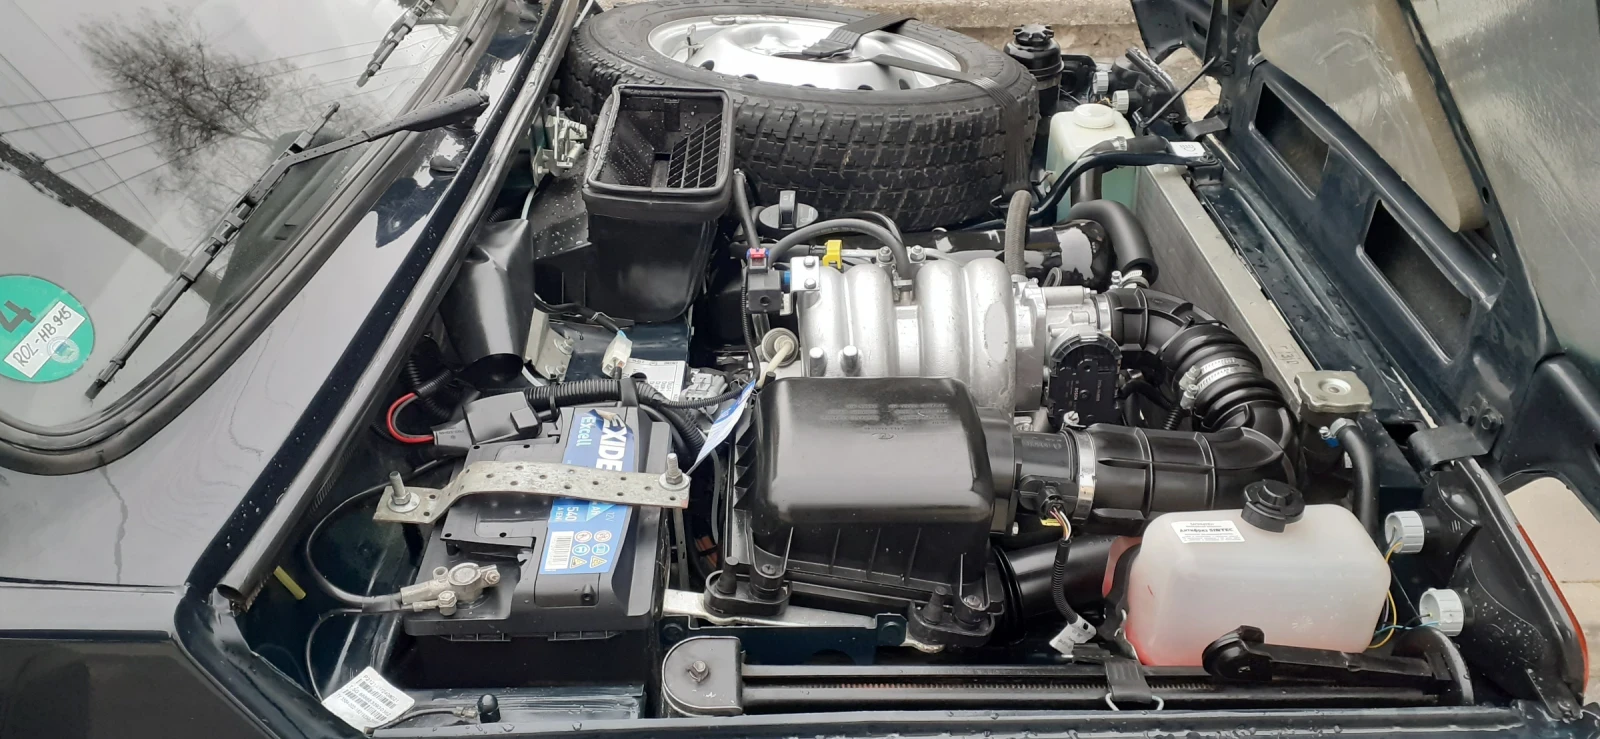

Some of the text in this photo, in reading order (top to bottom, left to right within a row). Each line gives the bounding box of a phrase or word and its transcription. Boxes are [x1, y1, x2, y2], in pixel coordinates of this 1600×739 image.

[0, 300, 36, 333] 4
[12, 342, 40, 367] ROL
[575, 416, 597, 447] Excell
[595, 414, 627, 471] EXIDE
[564, 506, 580, 521] 540
